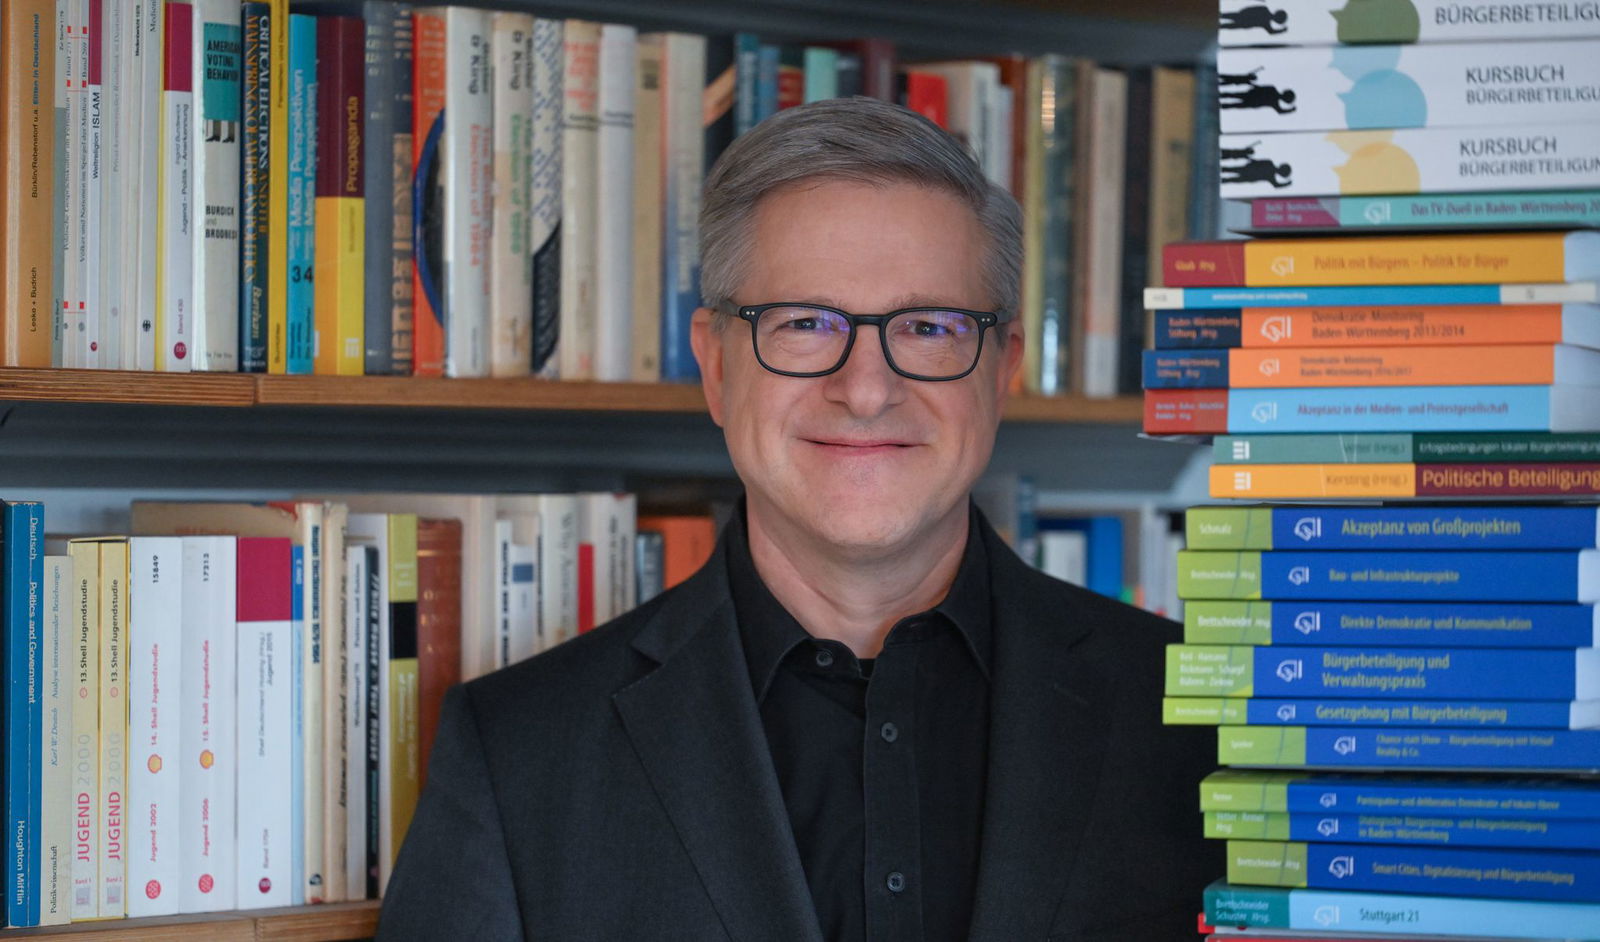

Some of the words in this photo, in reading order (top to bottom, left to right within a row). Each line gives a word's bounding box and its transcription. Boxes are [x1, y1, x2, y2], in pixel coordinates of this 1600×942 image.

[33, 13, 41, 67] Deutschland
[259, 15, 270, 83] CRITICAL
[1466, 66, 1565, 86] KURSBUCH
[92, 91, 100, 129] ISLAM
[259, 88, 270, 169] ELECTIONS
[290, 68, 304, 172] Perspektiven
[303, 82, 316, 177] Perspektiven
[31, 124, 39, 198] Bürklin/Rebenstorf
[345, 96, 360, 193] Propaganda
[1459, 137, 1557, 157] KURSBUCH
[290, 178, 303, 227] Media
[291, 265, 301, 284] 3
[1297, 403, 1341, 421] Akzeptanz
[1423, 468, 1504, 488] Politische
[1508, 467, 1600, 491] Beteiligung
[29, 516, 39, 560] Deutsch
[1341, 518, 1405, 539] Akzeptanz
[1407, 521, 1430, 536] von
[1432, 517, 1521, 540] Großprojekten
[52, 565, 61, 612] Beziehungen
[152, 555, 160, 584] 15849
[28, 581, 38, 618] Politics
[80, 578, 89, 644] Jugendstudie
[111, 578, 119, 644] Jugendstudie
[28, 618, 38, 641] and
[1340, 615, 1374, 630] Direkte
[1376, 615, 1431, 630] Demokratie
[1433, 616, 1453, 630] und
[1454, 616, 1533, 631] Kommunikation
[28, 641, 38, 704] Government
[80, 644, 88, 668] Shell
[152, 643, 160, 704] Jugendstudie
[1322, 651, 1425, 673] Bürgerbeteiligung
[1427, 652, 1450, 668] und
[52, 669, 60, 699] Analyse
[1322, 671, 1426, 690] Verwaltungspraxis
[1316, 705, 1388, 723] Gesetzgebung
[1391, 705, 1410, 720] mit
[1412, 705, 1507, 724] Bürgerbeteiligung
[78, 733, 90, 786] 2000
[15, 819, 26, 871] Houghton
[77, 792, 90, 863] JUGEND
[108, 791, 121, 861] JUGEND
[150, 829, 158, 863] Jugend
[17, 872, 26, 906] Mifflin
[50, 845, 58, 914] Politikwissenschaft
[1360, 908, 1405, 924] Stuttgart
[1406, 908, 1421, 922] 21
